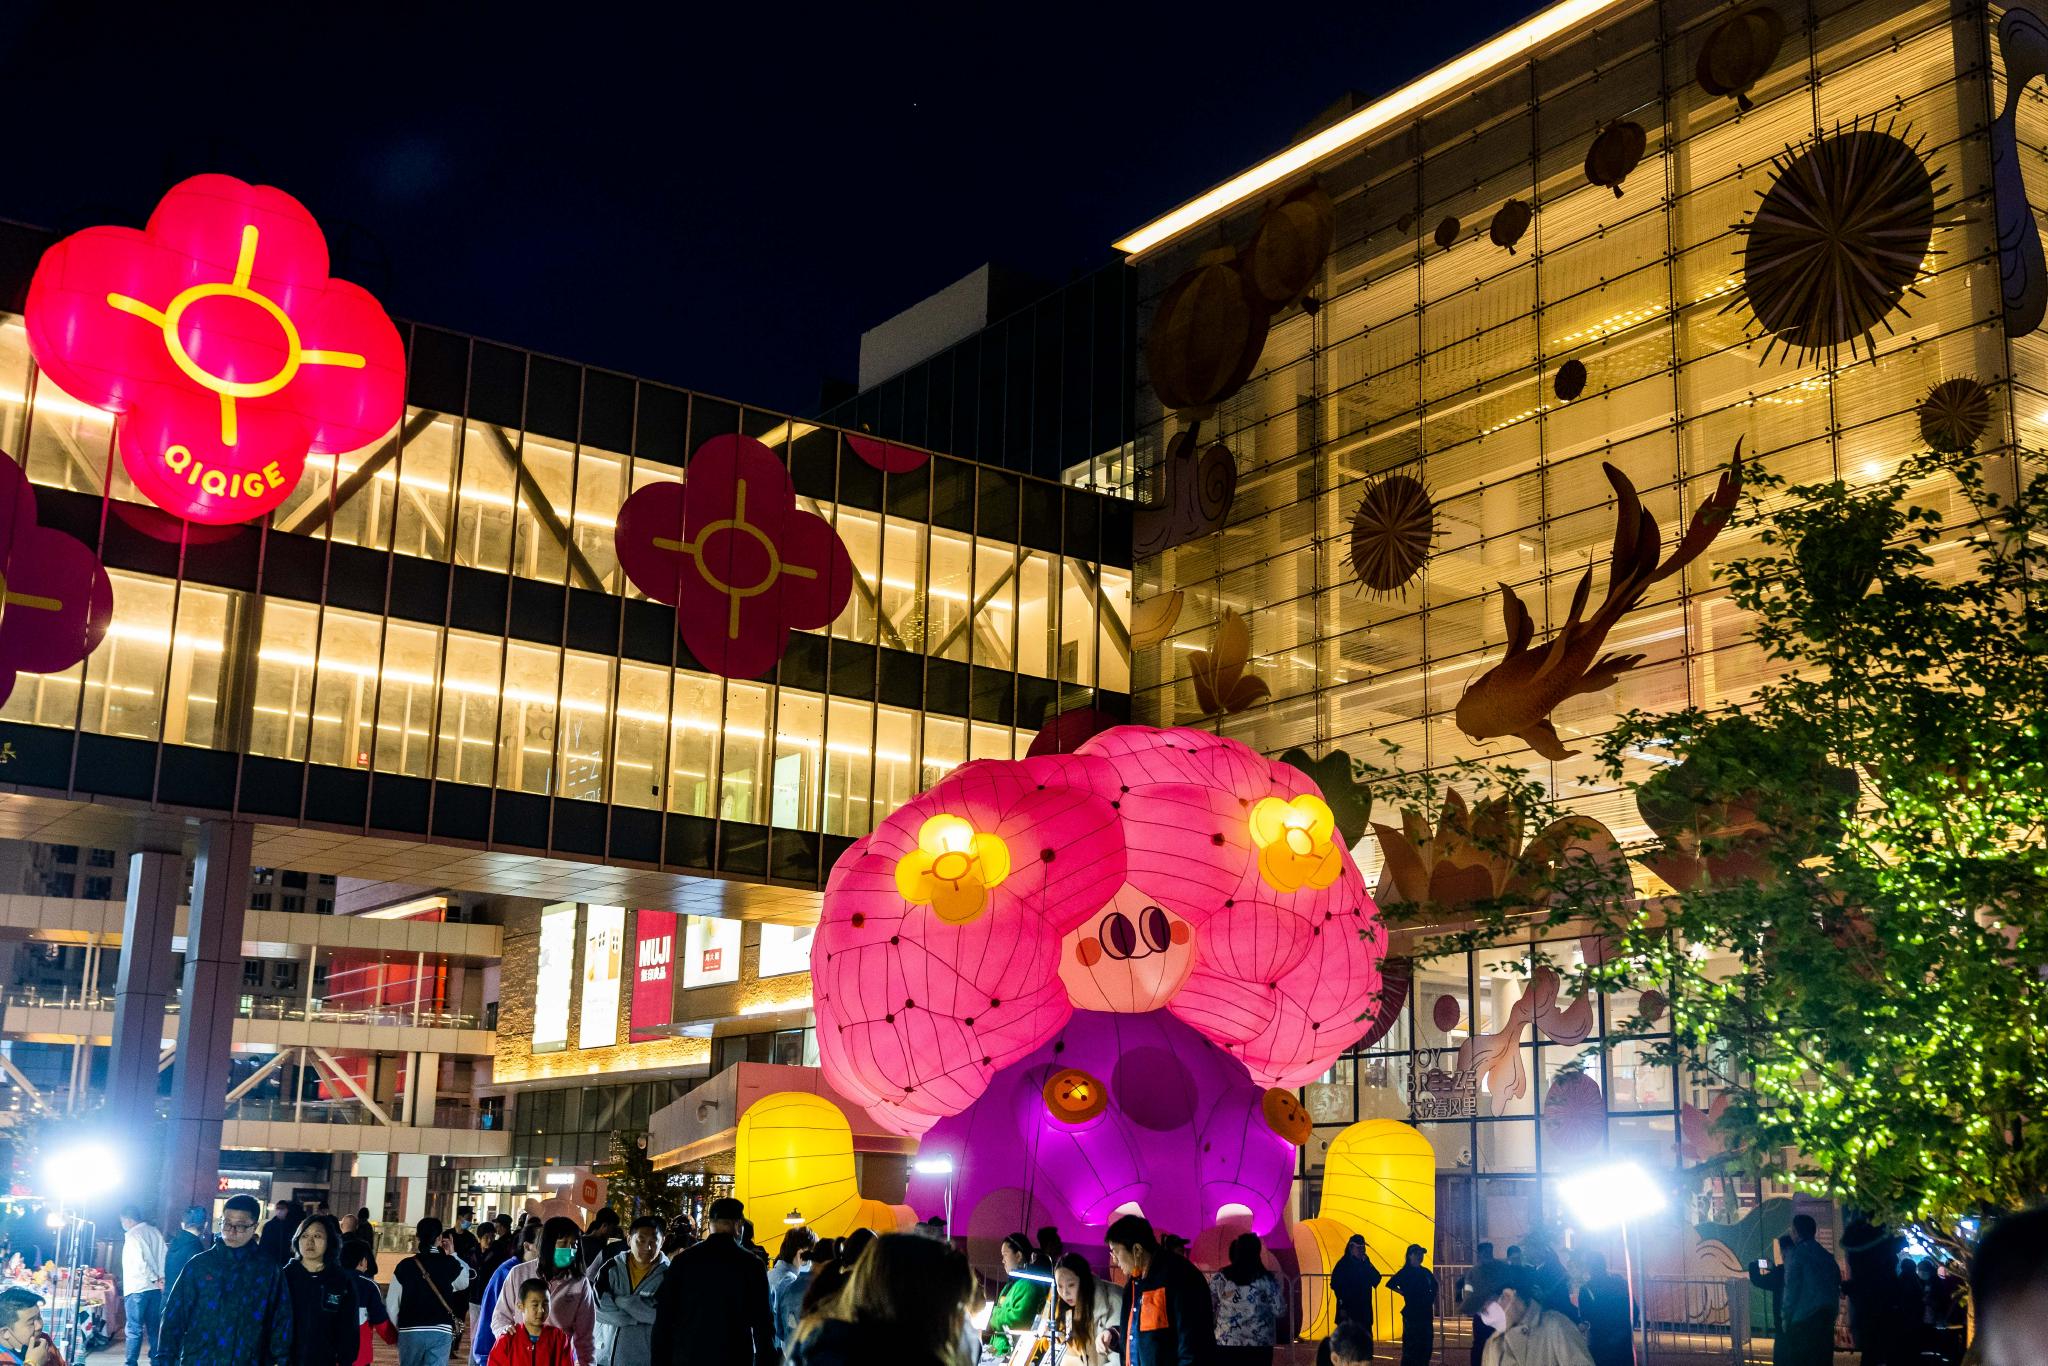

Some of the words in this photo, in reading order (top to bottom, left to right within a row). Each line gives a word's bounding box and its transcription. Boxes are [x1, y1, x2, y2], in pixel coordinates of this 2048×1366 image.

[164, 444, 286, 499] QIQIGE
[639, 936, 671, 967] MUJI
[1406, 1047, 1441, 1069] JOY
[1407, 1070, 1477, 1092] BREEZE
[1407, 1097, 1477, 1118] 大悦春风里
[474, 1170, 517, 1187] SEPHORA
